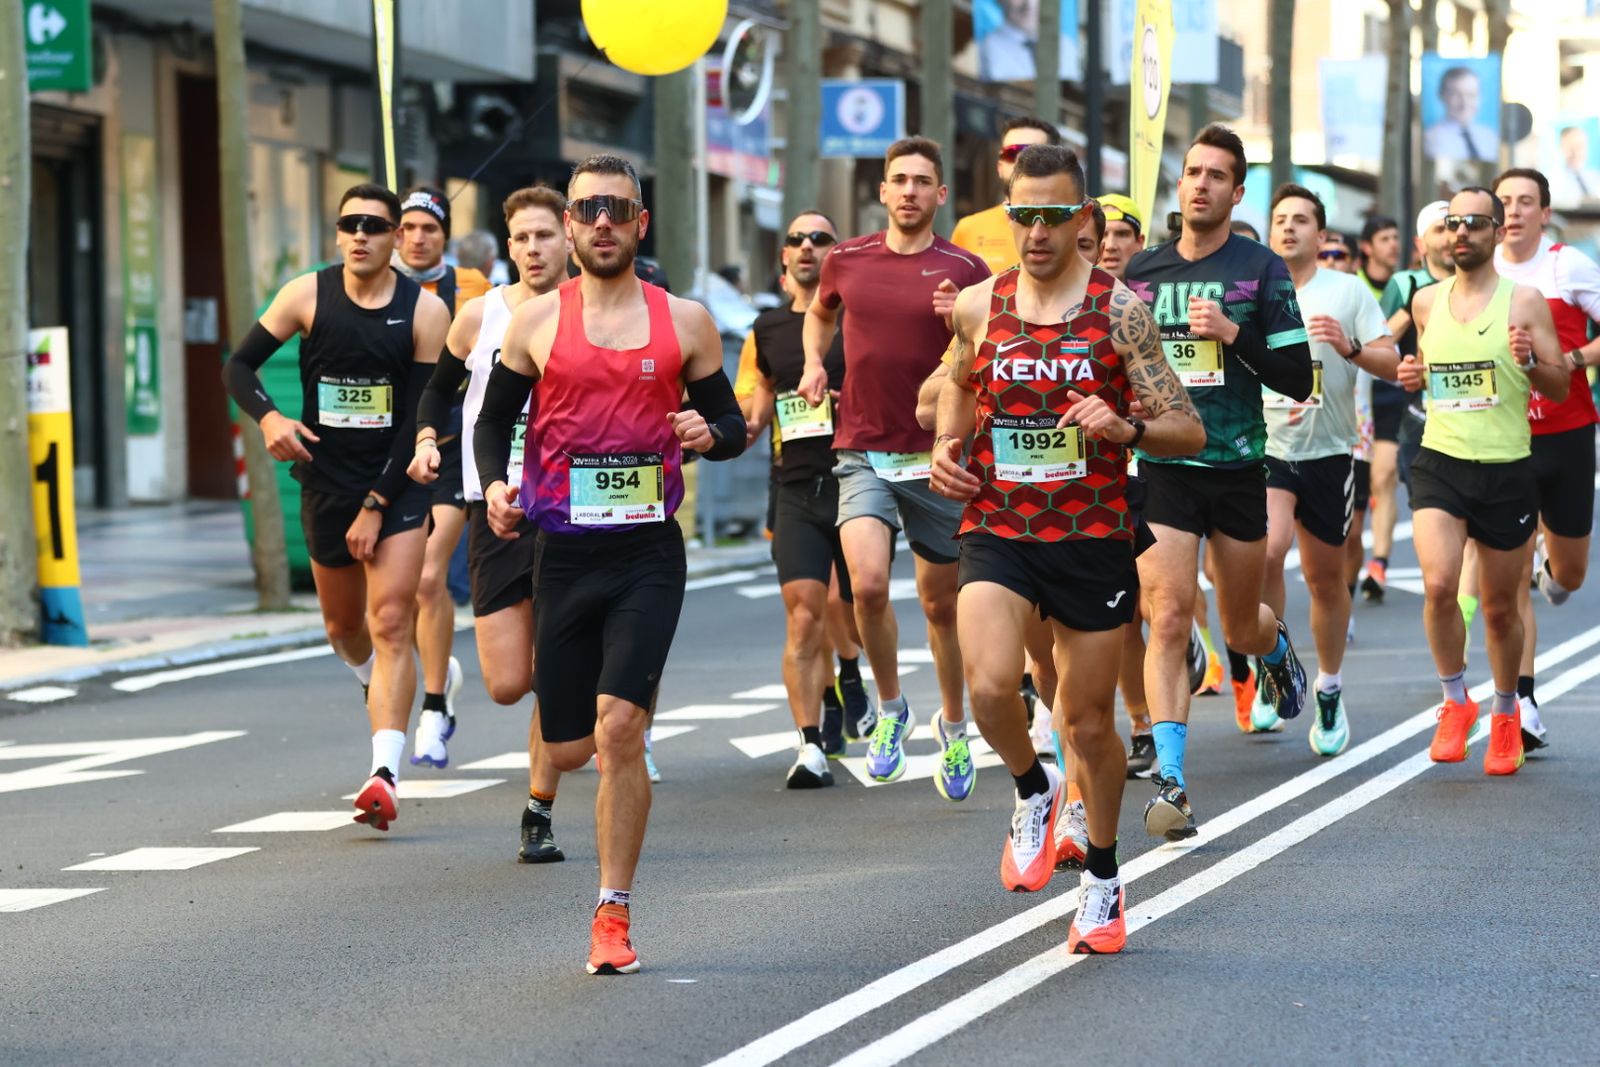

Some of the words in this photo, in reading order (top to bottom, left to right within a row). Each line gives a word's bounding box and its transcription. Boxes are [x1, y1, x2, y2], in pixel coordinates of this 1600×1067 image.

[1154, 281, 1224, 326] AVS
[1173, 344, 1196, 359] 36
[992, 358, 1095, 381] KENYA
[1442, 373, 1484, 389] 1345
[337, 388, 373, 403] 325
[784, 400, 814, 415] 219
[1009, 431, 1066, 450] 1992
[573, 457, 585, 466] XIV
[596, 470, 640, 490] 954
[35, 442, 65, 560] 1
[625, 511, 656, 520] bedunia
